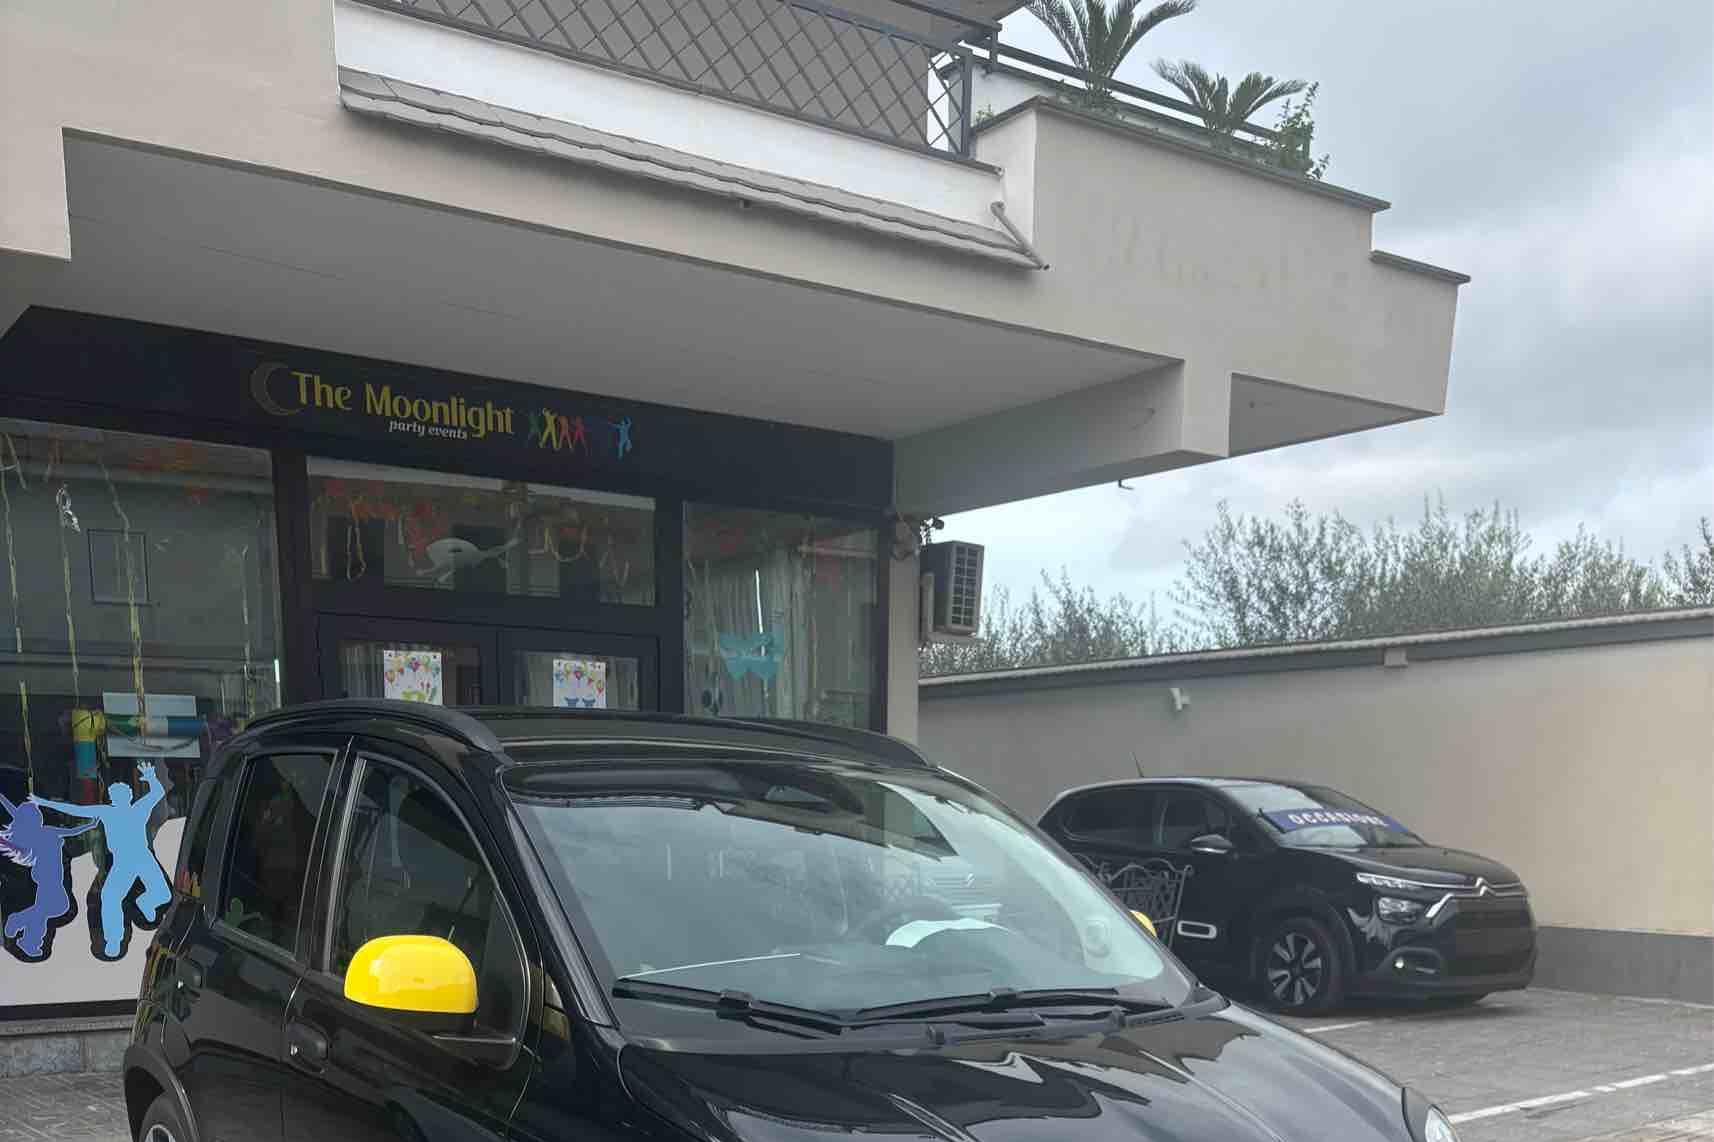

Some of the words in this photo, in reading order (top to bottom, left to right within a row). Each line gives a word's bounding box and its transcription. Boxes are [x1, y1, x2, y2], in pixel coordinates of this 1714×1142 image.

[290, 371, 352, 411] The
[364, 382, 515, 438] Moonlight
[389, 419, 425, 437] party
[427, 424, 468, 440] events
